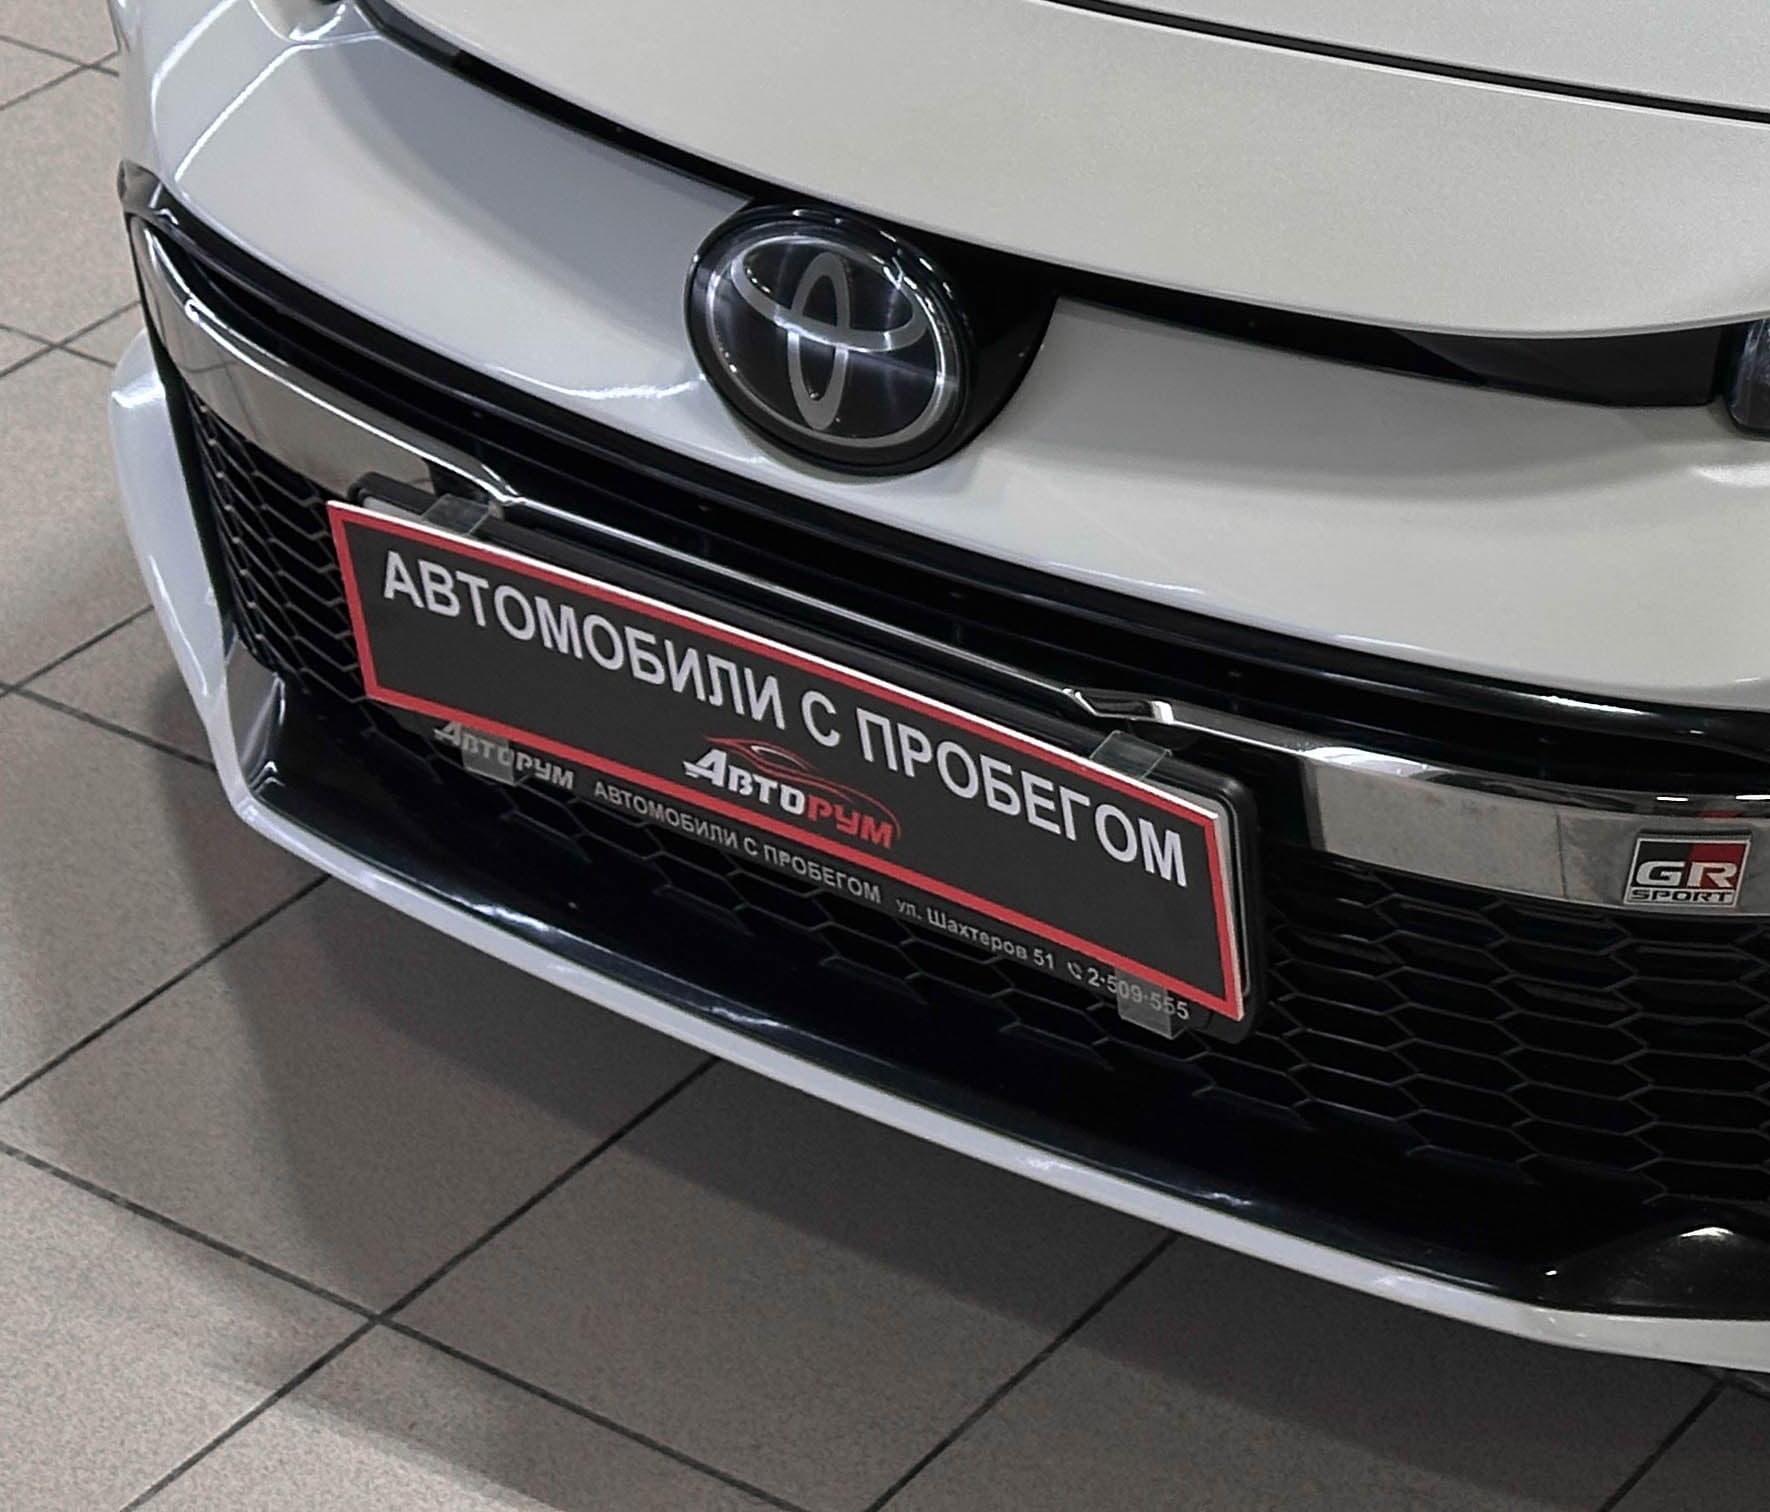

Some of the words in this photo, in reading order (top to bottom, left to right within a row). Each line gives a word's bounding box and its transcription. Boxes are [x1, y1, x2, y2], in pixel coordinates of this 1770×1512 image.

[384, 551, 785, 729] АВТОМОБИЛИ
[802, 690, 840, 746] С
[856, 708, 1187, 887] ПРОБЕГОМ
[595, 781, 738, 849] АВТОМОБИЛИ
[744, 837, 759, 856] С
[764, 845, 881, 904] ПРОБЕГОМ
[896, 898, 921, 920] ул.
[927, 907, 1028, 960] Шахтеров
[1034, 948, 1055, 969] 51
[1631, 889, 1732, 902] SPORT
[1635, 860, 1738, 888] GR
